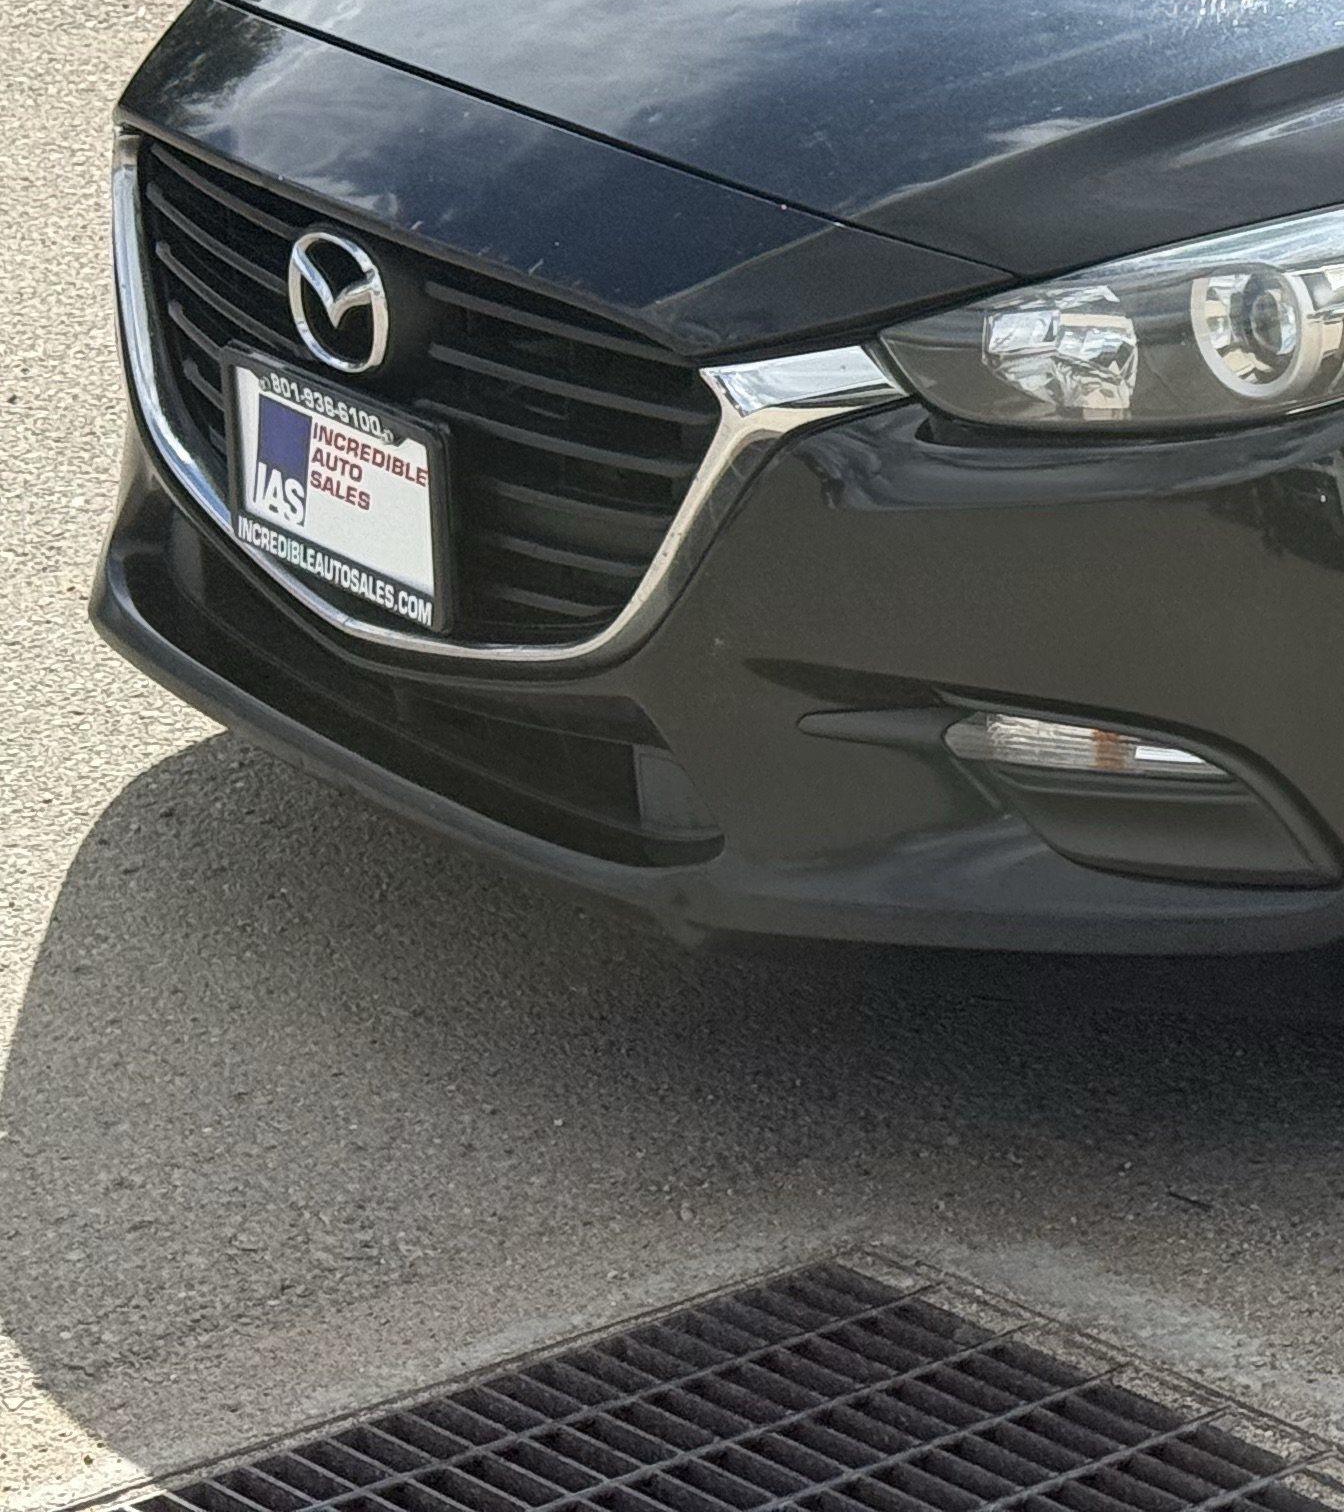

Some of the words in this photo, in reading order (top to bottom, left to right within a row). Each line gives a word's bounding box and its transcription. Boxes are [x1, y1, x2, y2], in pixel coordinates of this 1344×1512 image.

[311, 448, 363, 483] AUTO
[313, 422, 428, 488] INCREDIBLE
[255, 462, 304, 525] IAS
[310, 470, 371, 511] SALES
[237, 515, 432, 626] INCREDIBLEAUTOSALES.COM
